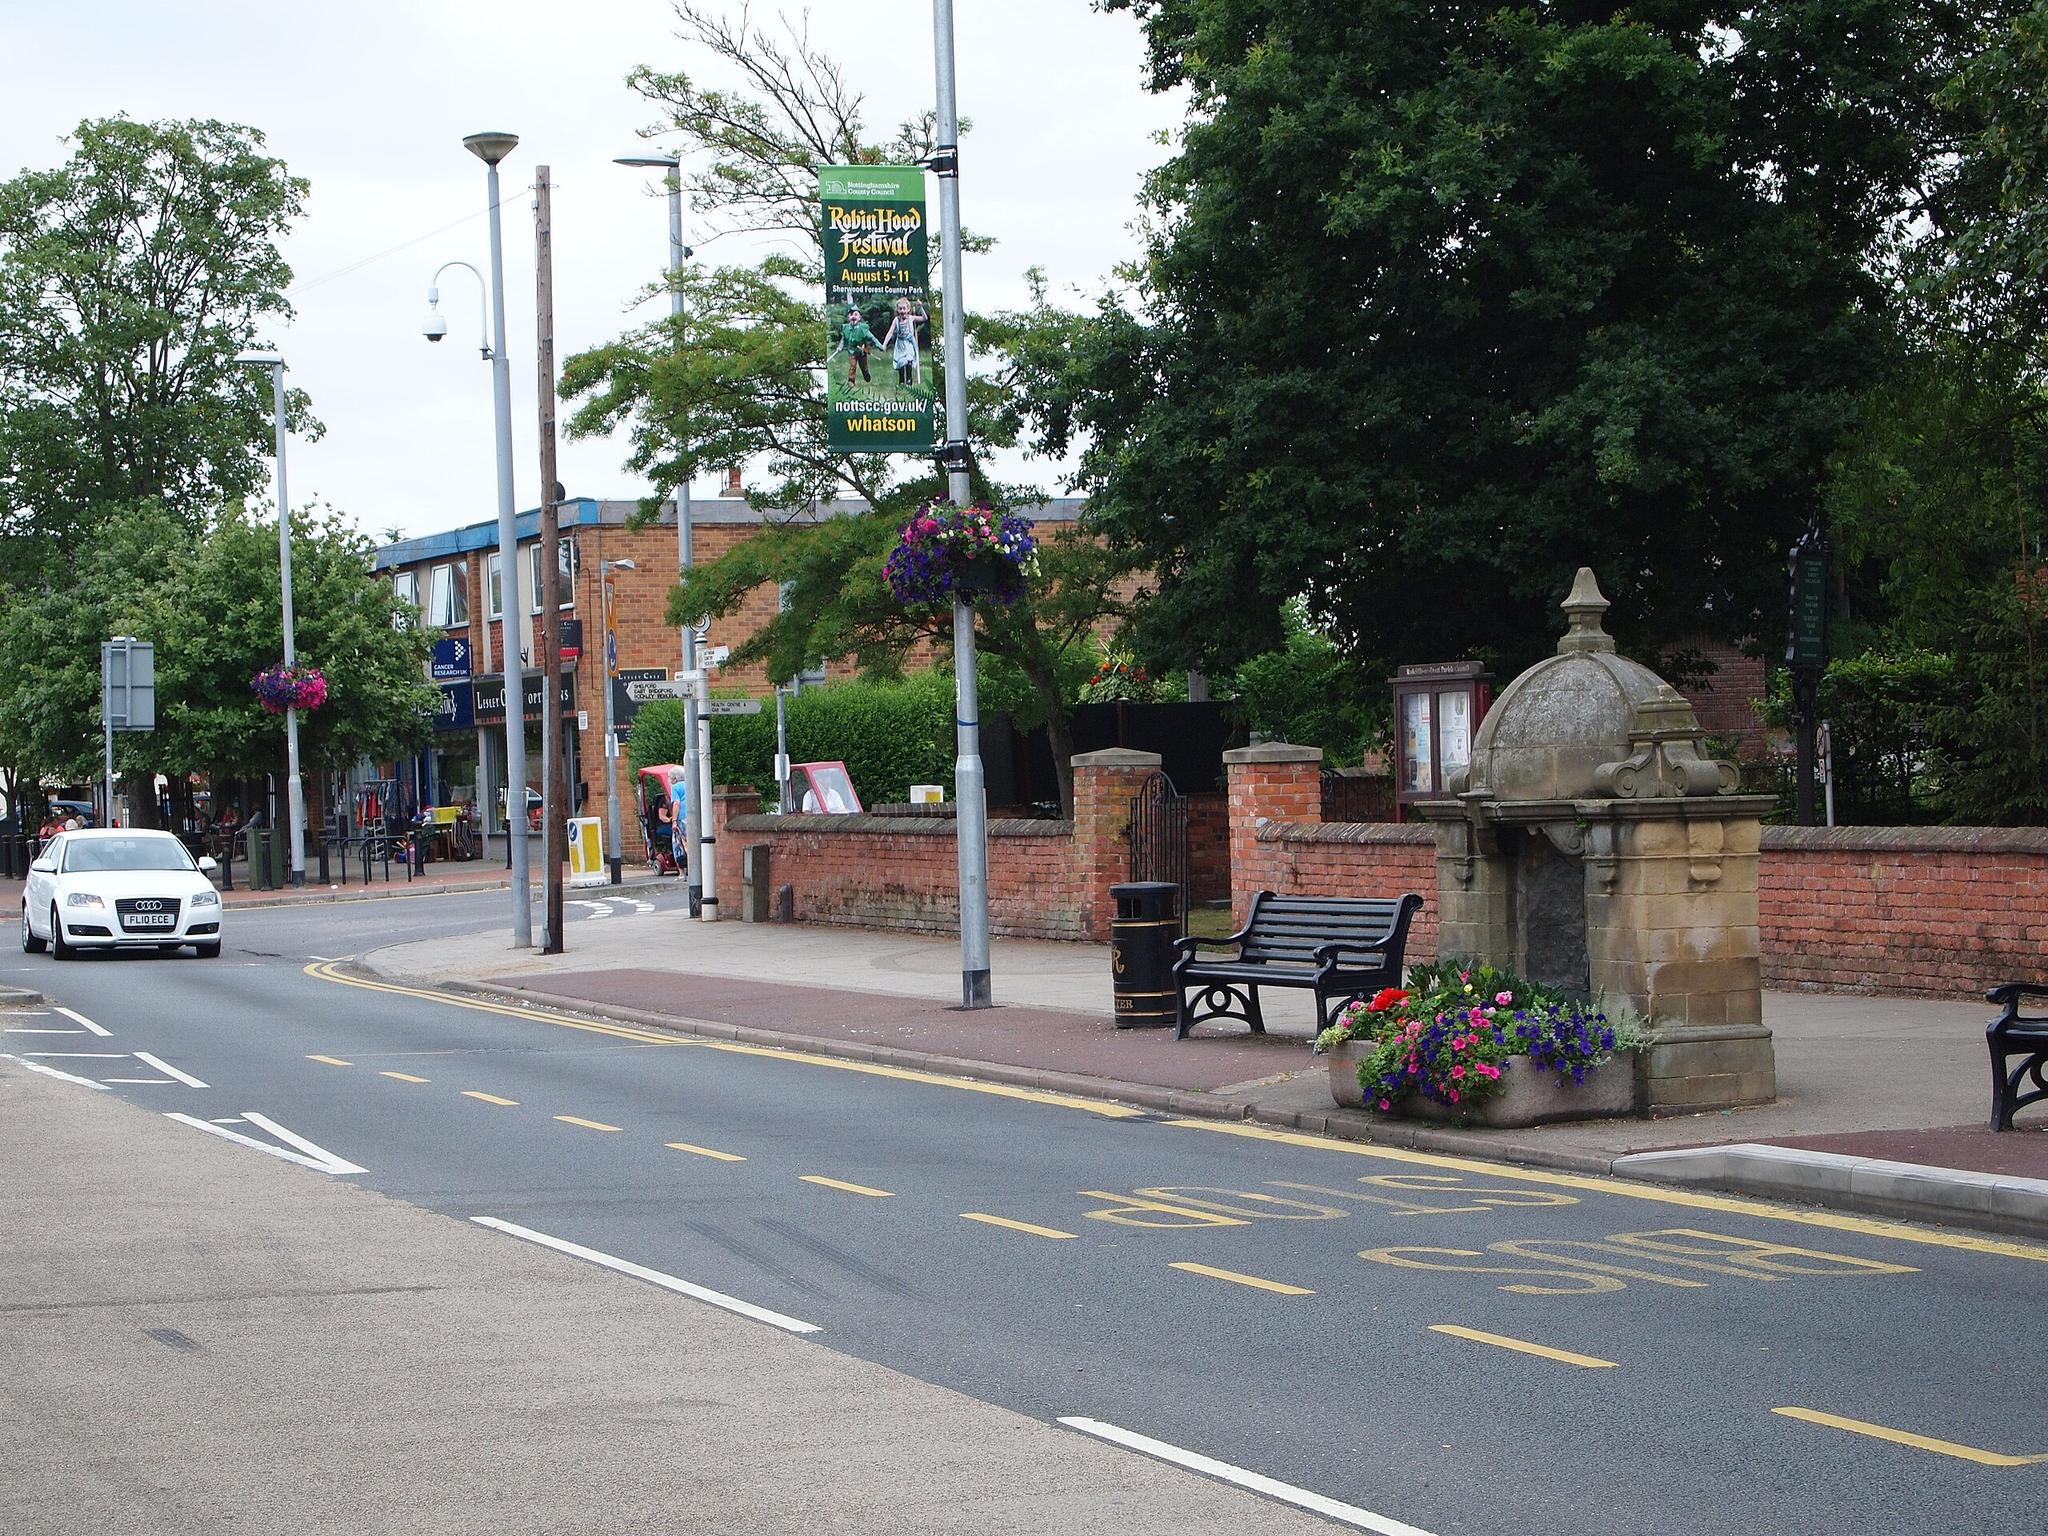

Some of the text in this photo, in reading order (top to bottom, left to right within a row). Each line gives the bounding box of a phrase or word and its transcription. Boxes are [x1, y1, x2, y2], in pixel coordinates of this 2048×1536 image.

[847, 181, 900, 190] Nottinghamshire
[847, 188, 870, 196] County
[828, 205, 921, 233] Robin Hood
[837, 230, 913, 263] Festival
[857, 258, 897, 269] FREE entry
[842, 269, 881, 284] August
[832, 285, 923, 295] Sherwood Forest Country Park
[835, 399, 927, 414] nottscc.gov.uk/
[847, 414, 916, 432] whatson
[433, 663, 454, 671] CANCER
[477, 691, 499, 709] LESLEY
[130, 915, 169, 924] FL10 ECE
[1077, 1175, 1581, 1228] STOP
[1357, 1228, 1924, 1295] BUS
